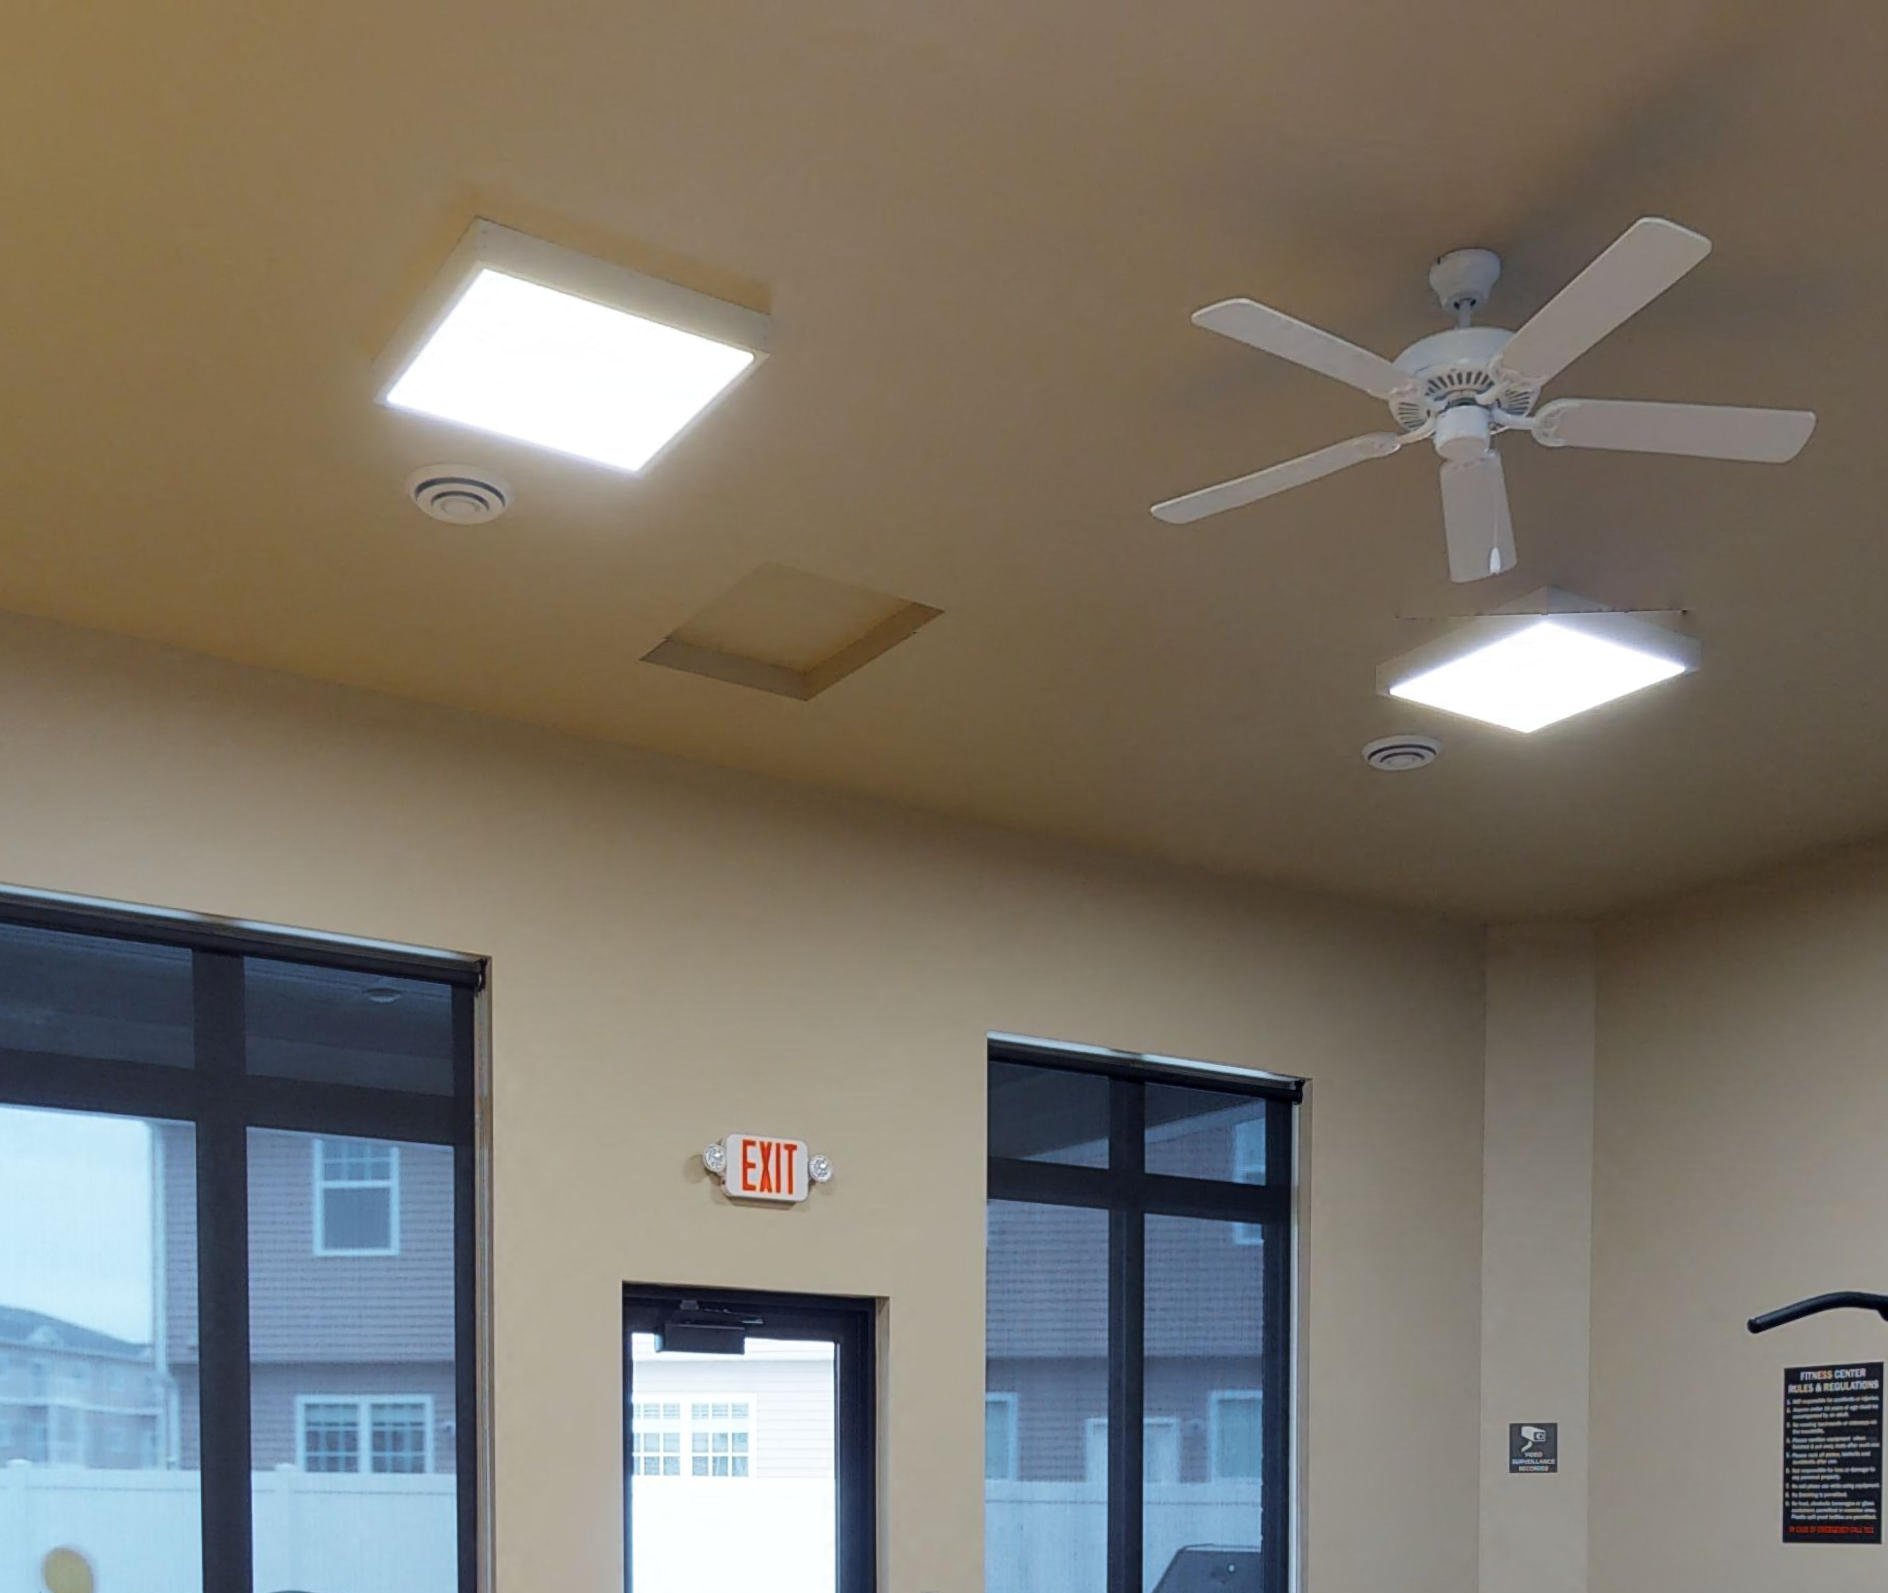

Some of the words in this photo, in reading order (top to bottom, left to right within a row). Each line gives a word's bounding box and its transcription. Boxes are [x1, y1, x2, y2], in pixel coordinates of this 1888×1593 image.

[742, 1139, 798, 1195] EXIT
[1800, 1370, 1832, 1380] FITNESS
[1834, 1368, 1866, 1379] CENTER
[1788, 1383, 1814, 1394] RULES
[1823, 1380, 1879, 1391] REGULATIONS
